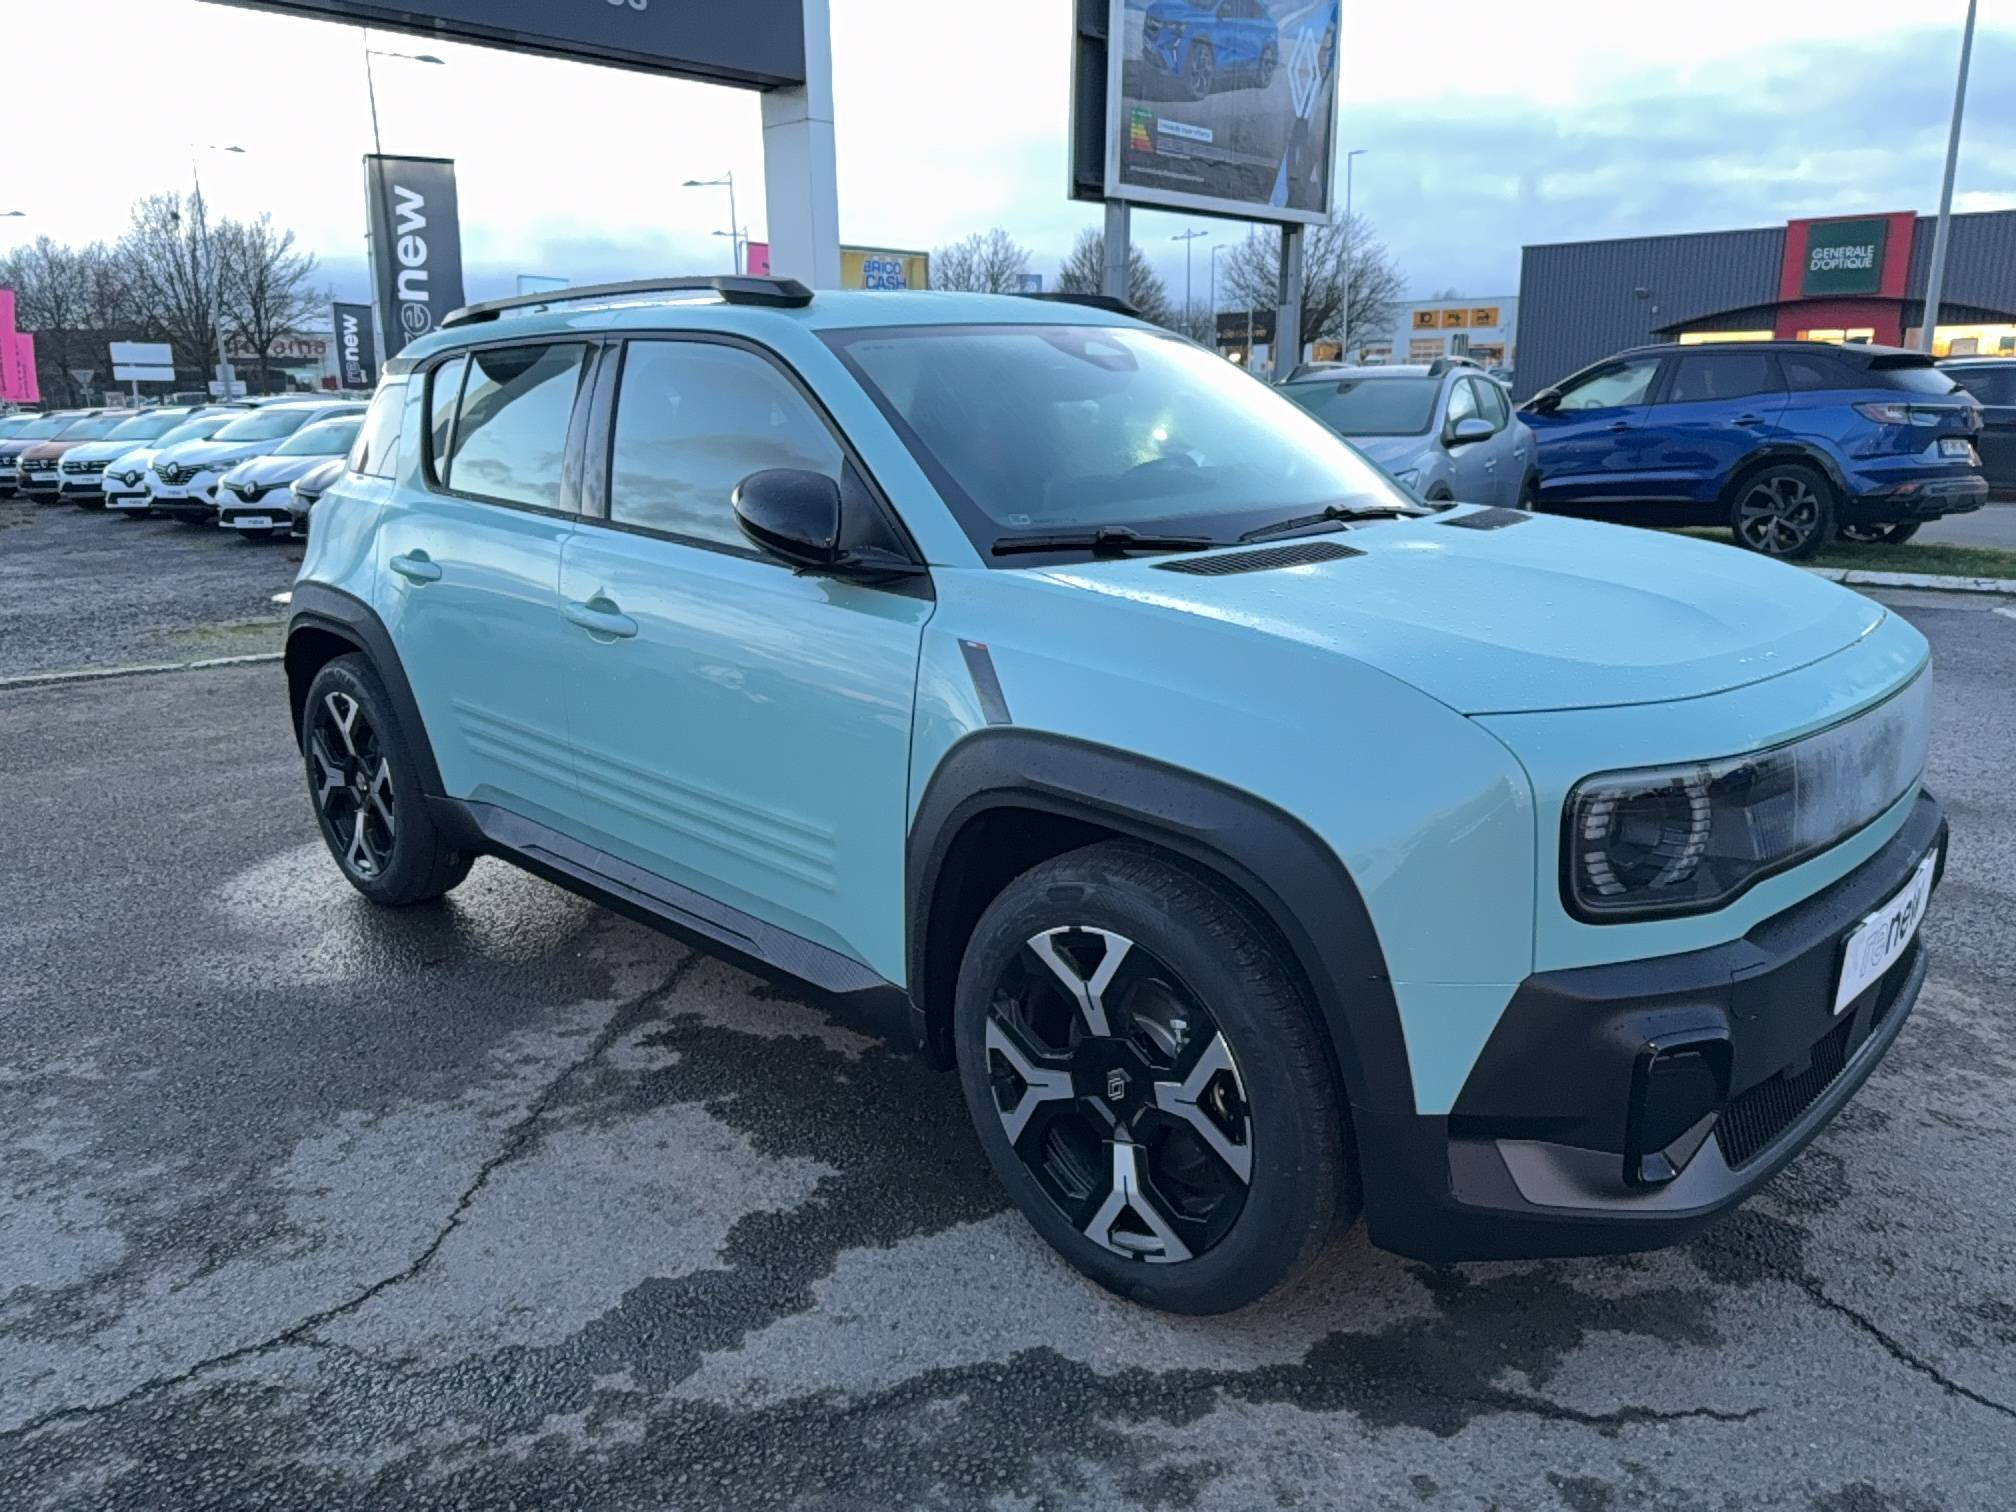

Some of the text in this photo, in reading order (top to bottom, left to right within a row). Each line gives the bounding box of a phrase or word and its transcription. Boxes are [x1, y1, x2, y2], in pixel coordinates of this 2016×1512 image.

[1811, 245, 1874, 259] GENERALE
[864, 259, 901, 274] BRICO
[1810, 258, 1873, 271] D'OPTIQUE
[866, 275, 906, 290] CASH
